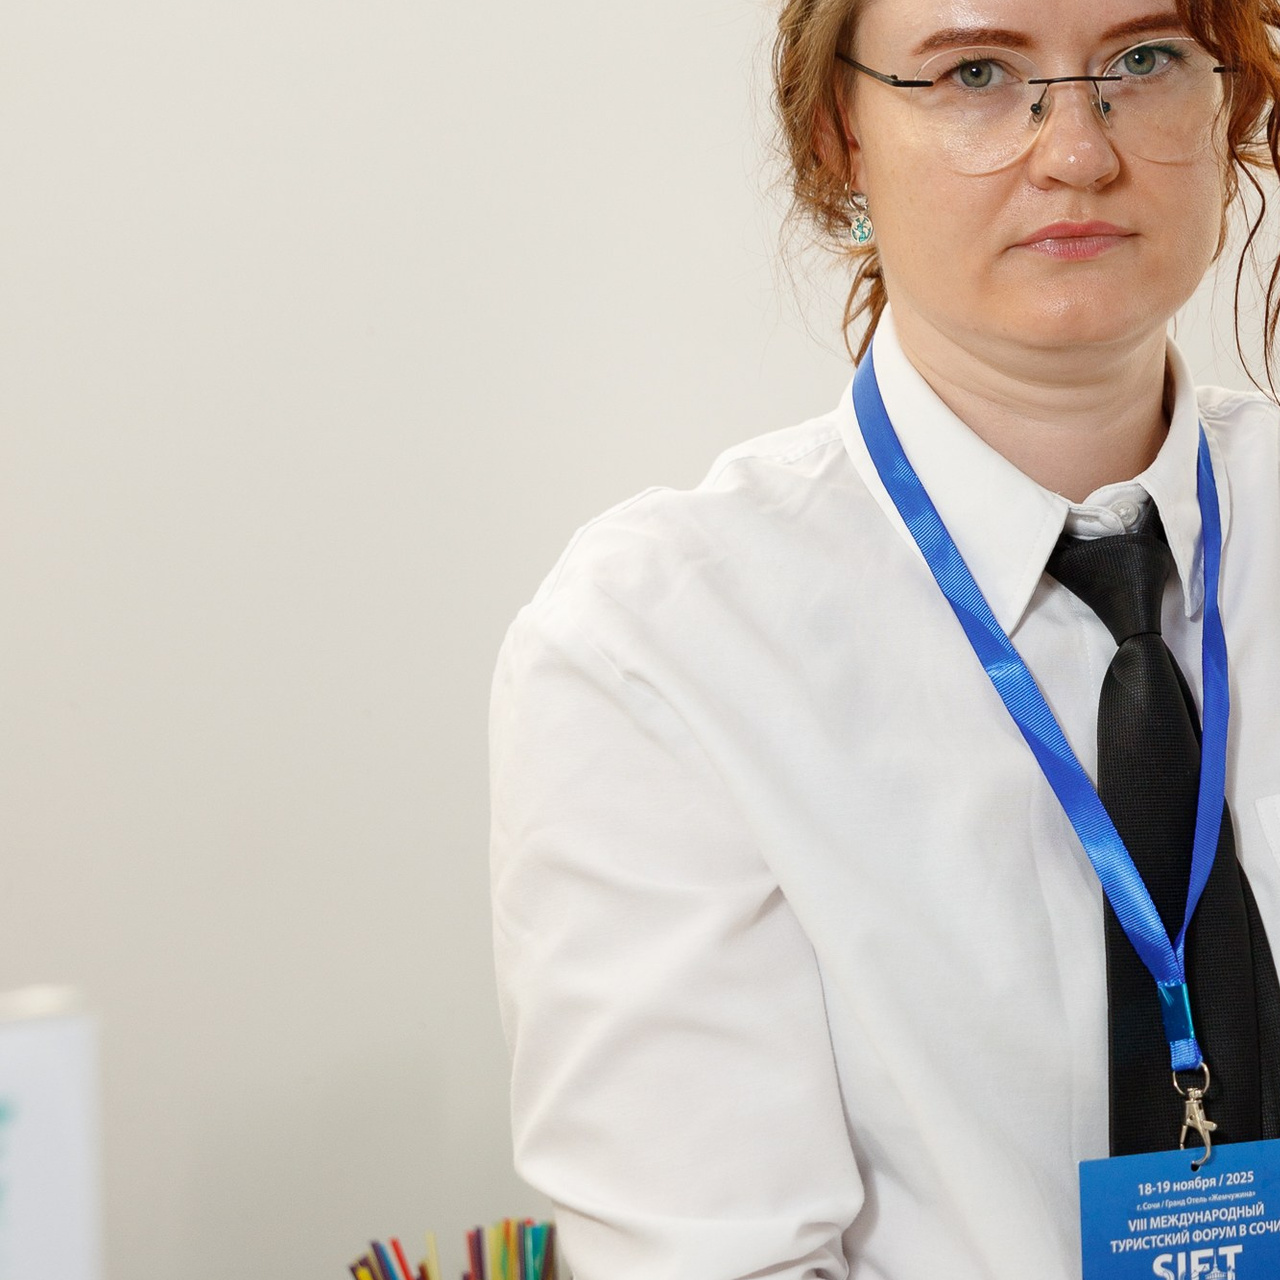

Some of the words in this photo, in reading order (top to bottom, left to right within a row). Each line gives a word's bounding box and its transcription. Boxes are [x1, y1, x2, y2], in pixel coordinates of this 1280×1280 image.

[1138, 1180, 1170, 1196] 18-19
[1173, 1176, 1216, 1192] ноября
[1226, 1171, 1254, 1186] 2025
[1143, 1201, 1160, 1210] Сочи
[1165, 1198, 1186, 1209] Гранд
[1187, 1195, 1208, 1206] Отель
[1208, 1190, 1256, 1203] «Жемчужина»
[1128, 1218, 1147, 1232] VIII
[1150, 1202, 1265, 1229] МЕЖДУНАРОДНЫЙ
[1110, 1230, 1190, 1253] ТУРИСТСКИЙ
[1192, 1225, 1236, 1242] ФОРУМ
[1239, 1224, 1247, 1236] В
